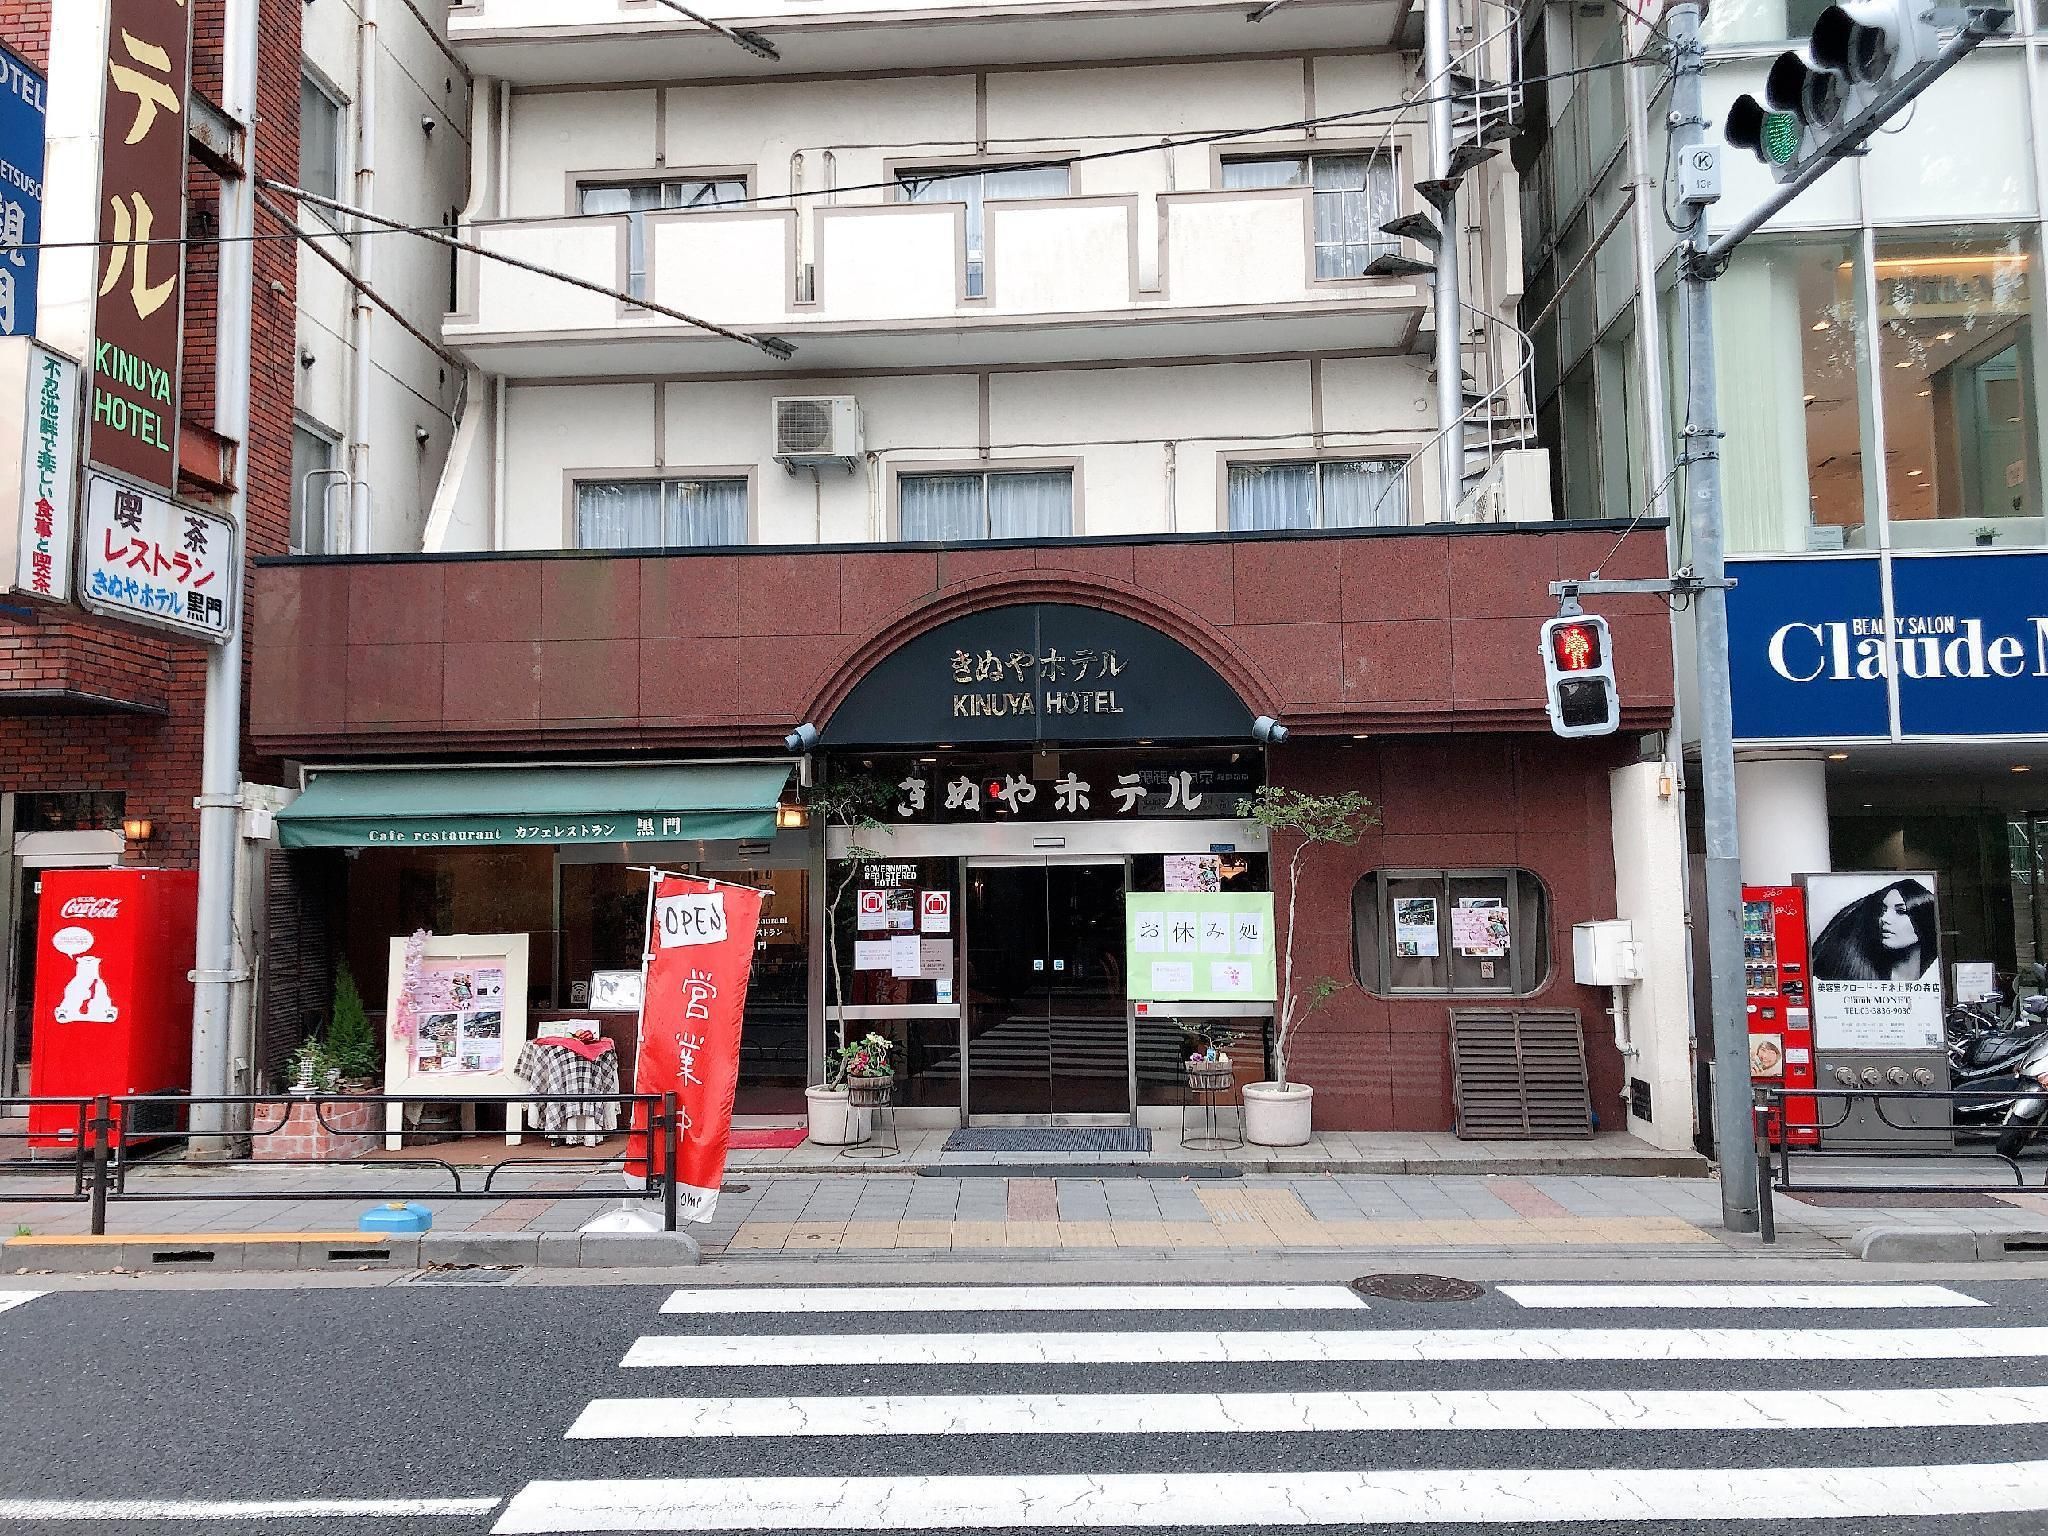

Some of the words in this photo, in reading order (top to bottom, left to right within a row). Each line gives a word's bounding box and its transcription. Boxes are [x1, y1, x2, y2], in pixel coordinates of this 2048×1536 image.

[0, 53, 46, 115] OTEL
[98, 0, 184, 320] テル
[0, 158, 42, 201] ETSUSO
[95, 336, 171, 405] KINUYA
[94, 387, 169, 452] HOTEL
[104, 528, 215, 588] レストラン
[92, 568, 184, 615] きぬやホテル
[187, 591, 222, 626] 黒門
[1852, 616, 1905, 636] BEAUY
[1908, 616, 1955, 635] SALON
[950, 647, 1130, 684] きぬやホテル
[1768, 618, 2025, 682] Claude
[953, 691, 1036, 717] KINUYA
[1046, 690, 1124, 714] HOTEL
[897, 771, 1202, 817] きぬやホテル
[368, 830, 405, 842] Cafe
[413, 828, 501, 841] restaurant
[514, 824, 616, 839] カフェレストラン
[636, 817, 681, 836] 黒門
[874, 879, 902, 887] HOTEL
[665, 903, 721, 936] OPEN
[756, 928, 783, 937] ストラン
[1140, 921, 1258, 943] お休み処
[756, 941, 767, 951] 門
